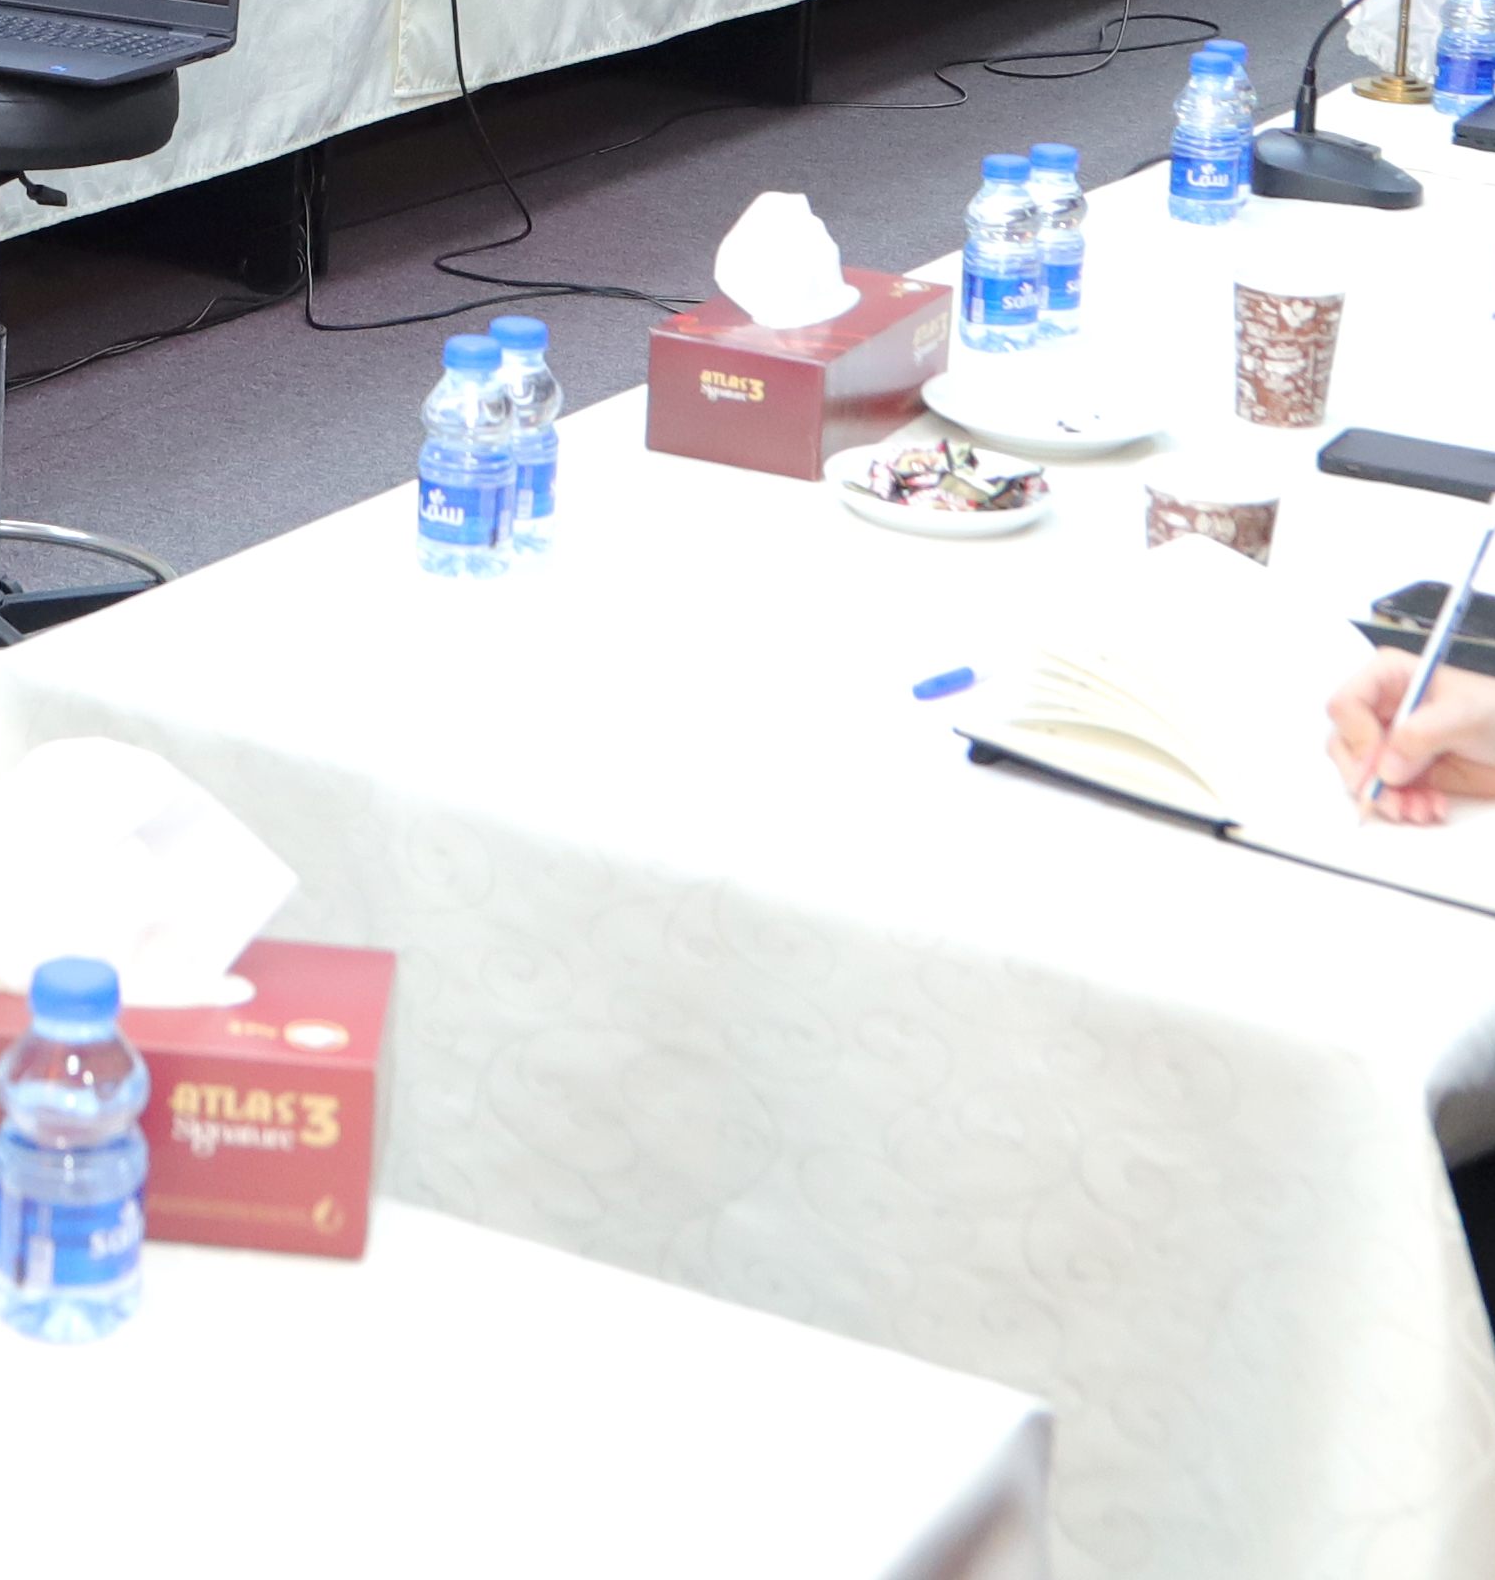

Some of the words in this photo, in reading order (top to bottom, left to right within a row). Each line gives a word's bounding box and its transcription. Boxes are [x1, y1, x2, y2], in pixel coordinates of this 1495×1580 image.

[1186, 168, 1229, 188] سما
[700, 369, 749, 390] ATLAS
[747, 377, 765, 402] 3
[168, 1082, 297, 1124] ATLAS
[298, 1093, 341, 1150] 3
